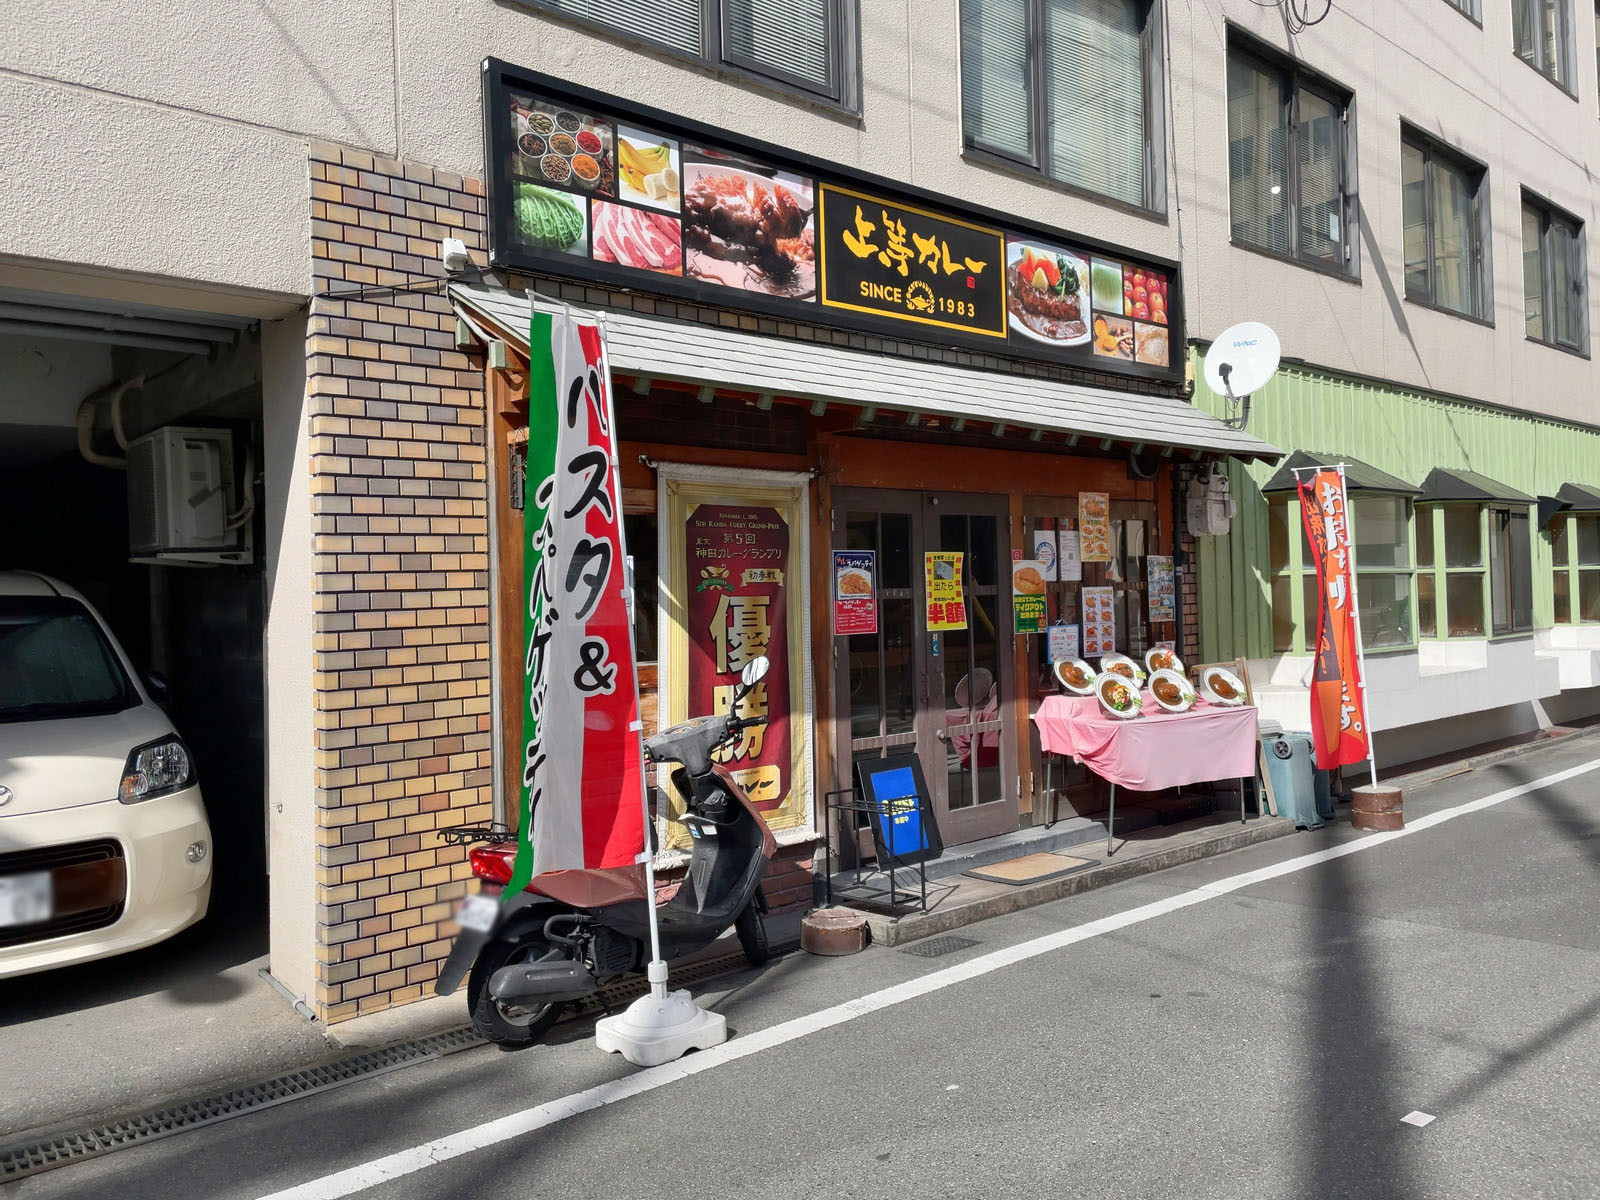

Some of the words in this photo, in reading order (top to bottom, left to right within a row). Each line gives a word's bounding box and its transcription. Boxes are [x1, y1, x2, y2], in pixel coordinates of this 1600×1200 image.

[842, 205, 987, 276] 上等カレー
[860, 280, 902, 303] SINCE
[939, 297, 975, 317] 1983
[723, 533, 756, 545] 第5回
[696, 548, 782, 559] 神田カレーグランプリ
[934, 581, 954, 591] 出たら
[928, 602, 965, 624] 半額
[1015, 603, 1044, 611] テイクアウト
[709, 594, 771, 762] 優勝
